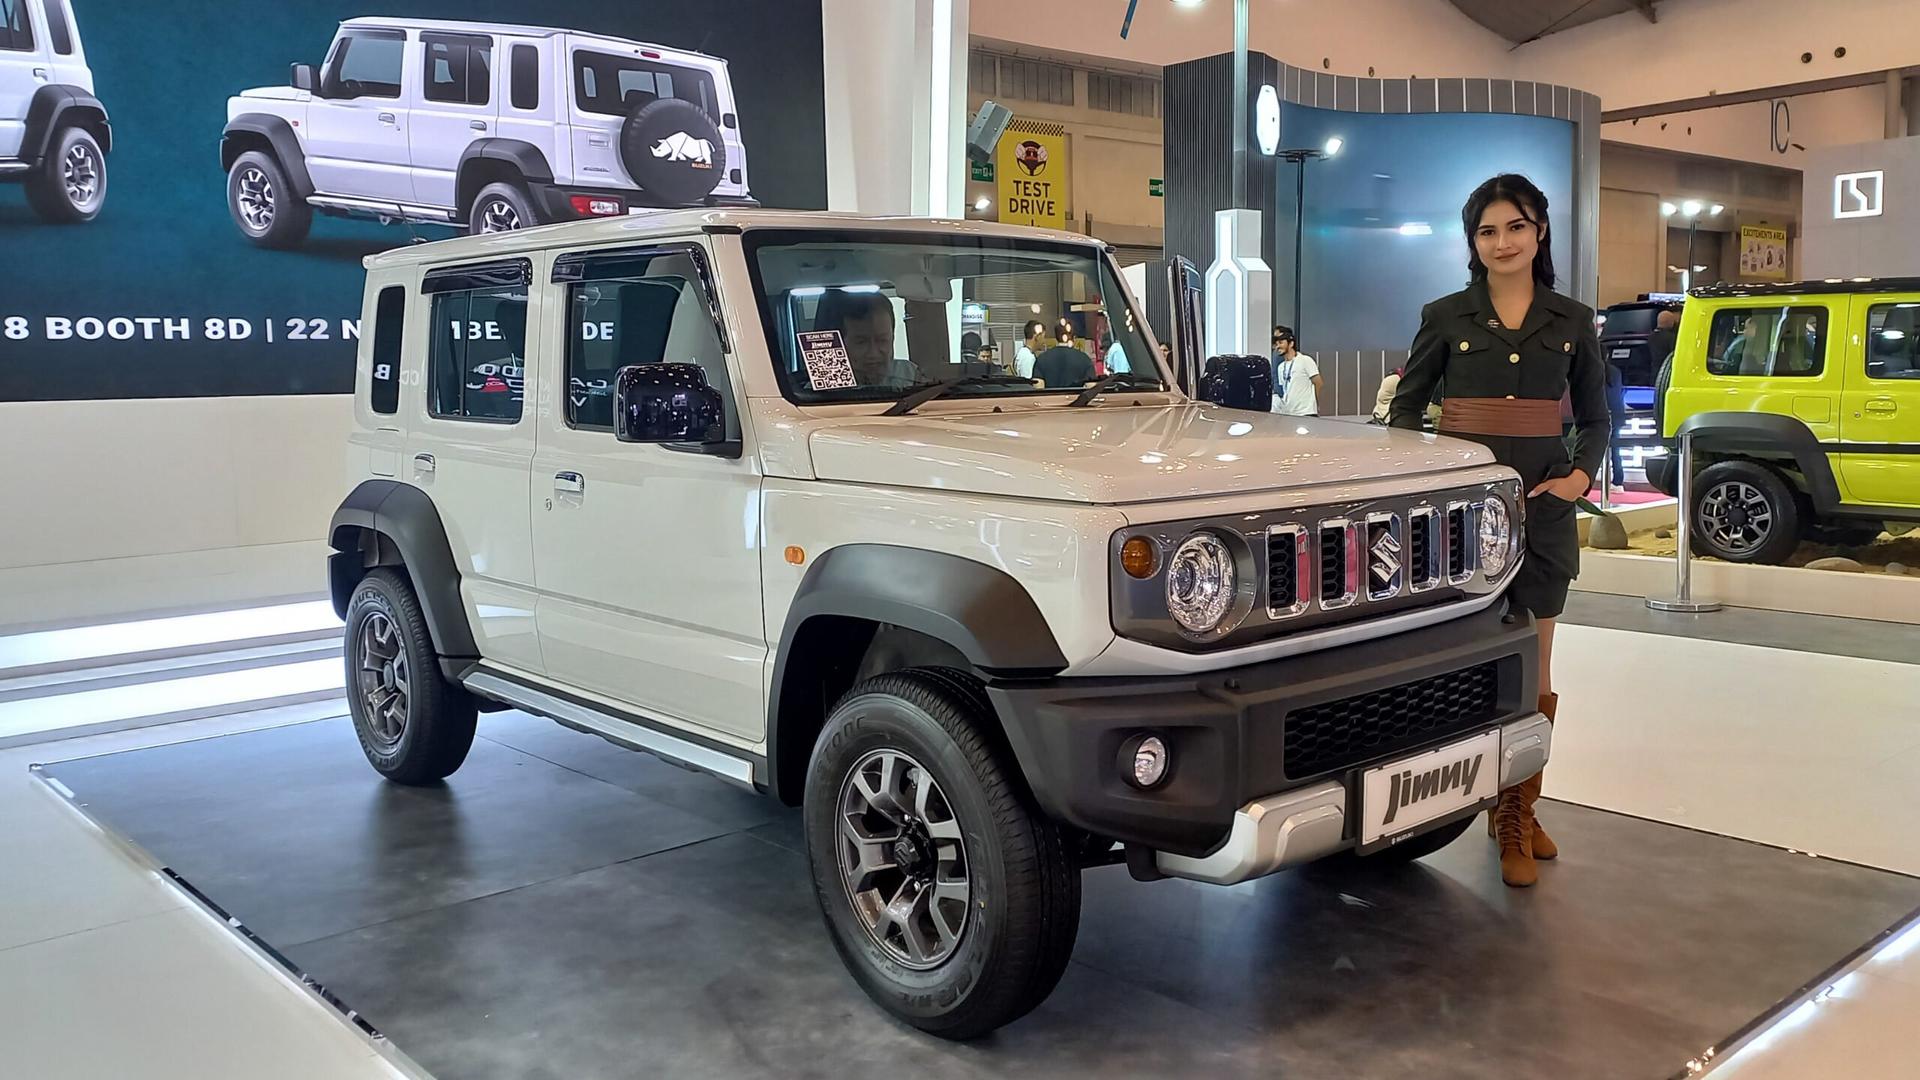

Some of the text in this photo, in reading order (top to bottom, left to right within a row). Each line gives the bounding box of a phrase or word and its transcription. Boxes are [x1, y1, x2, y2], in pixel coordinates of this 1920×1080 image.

[1013, 180, 1051, 198] TEST
[1009, 197, 1056, 216] DRIVE
[4, 316, 30, 340] 8
[45, 316, 190, 341] BOOTH
[204, 317, 252, 340] 8D
[286, 318, 330, 340] 22
[1382, 753, 1484, 826] Jimny
